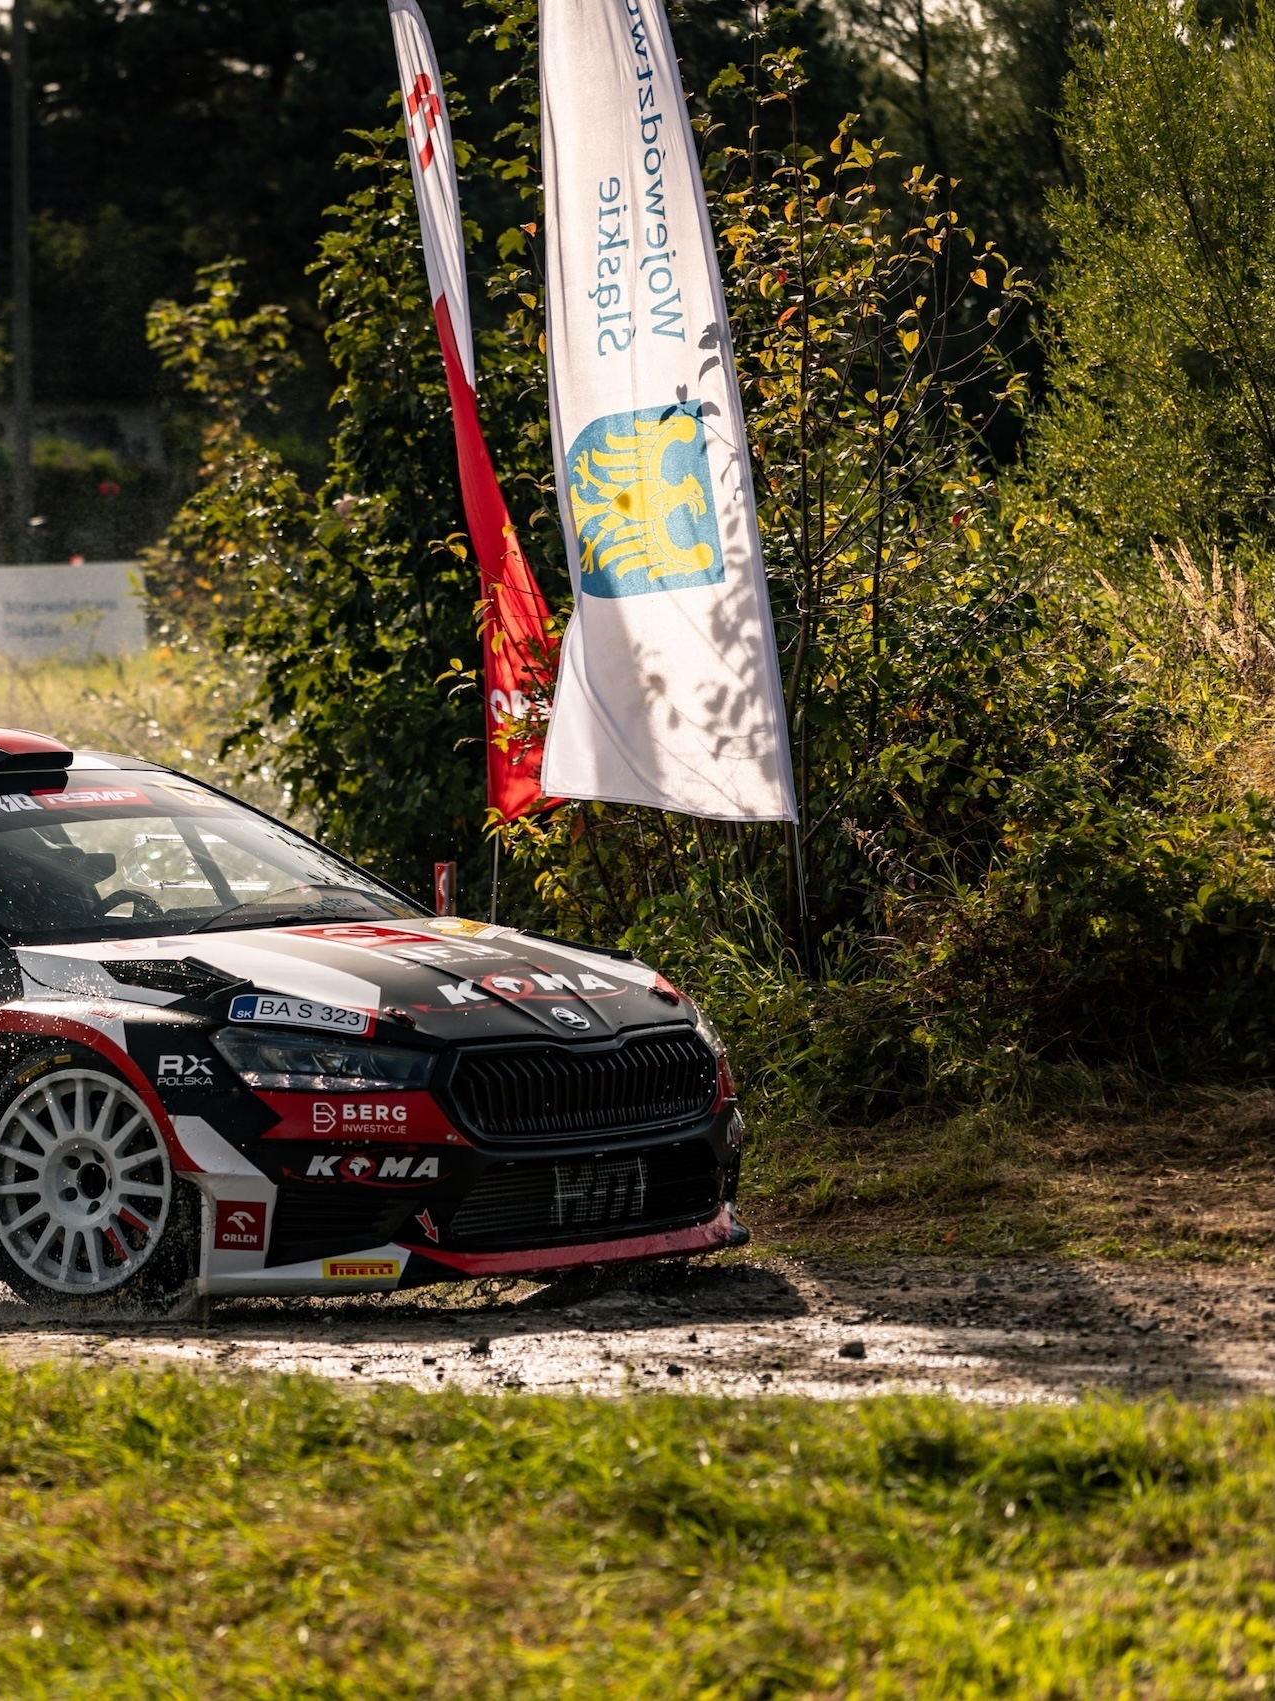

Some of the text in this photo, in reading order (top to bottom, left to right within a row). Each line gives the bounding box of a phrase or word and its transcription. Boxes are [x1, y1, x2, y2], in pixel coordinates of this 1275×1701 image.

[41, 788, 139, 805] RSMP
[236, 1002, 360, 1026] SK BA S 323
[158, 1055, 214, 1076] RX
[157, 1077, 213, 1086] POLSKA
[342, 1103, 407, 1121] BERG
[342, 1124, 407, 1135] INWESTYCJE
[306, 1155, 439, 1179] KOMA
[222, 1233, 257, 1243] ORLEN
[330, 1263, 393, 1276] PIRELLI
